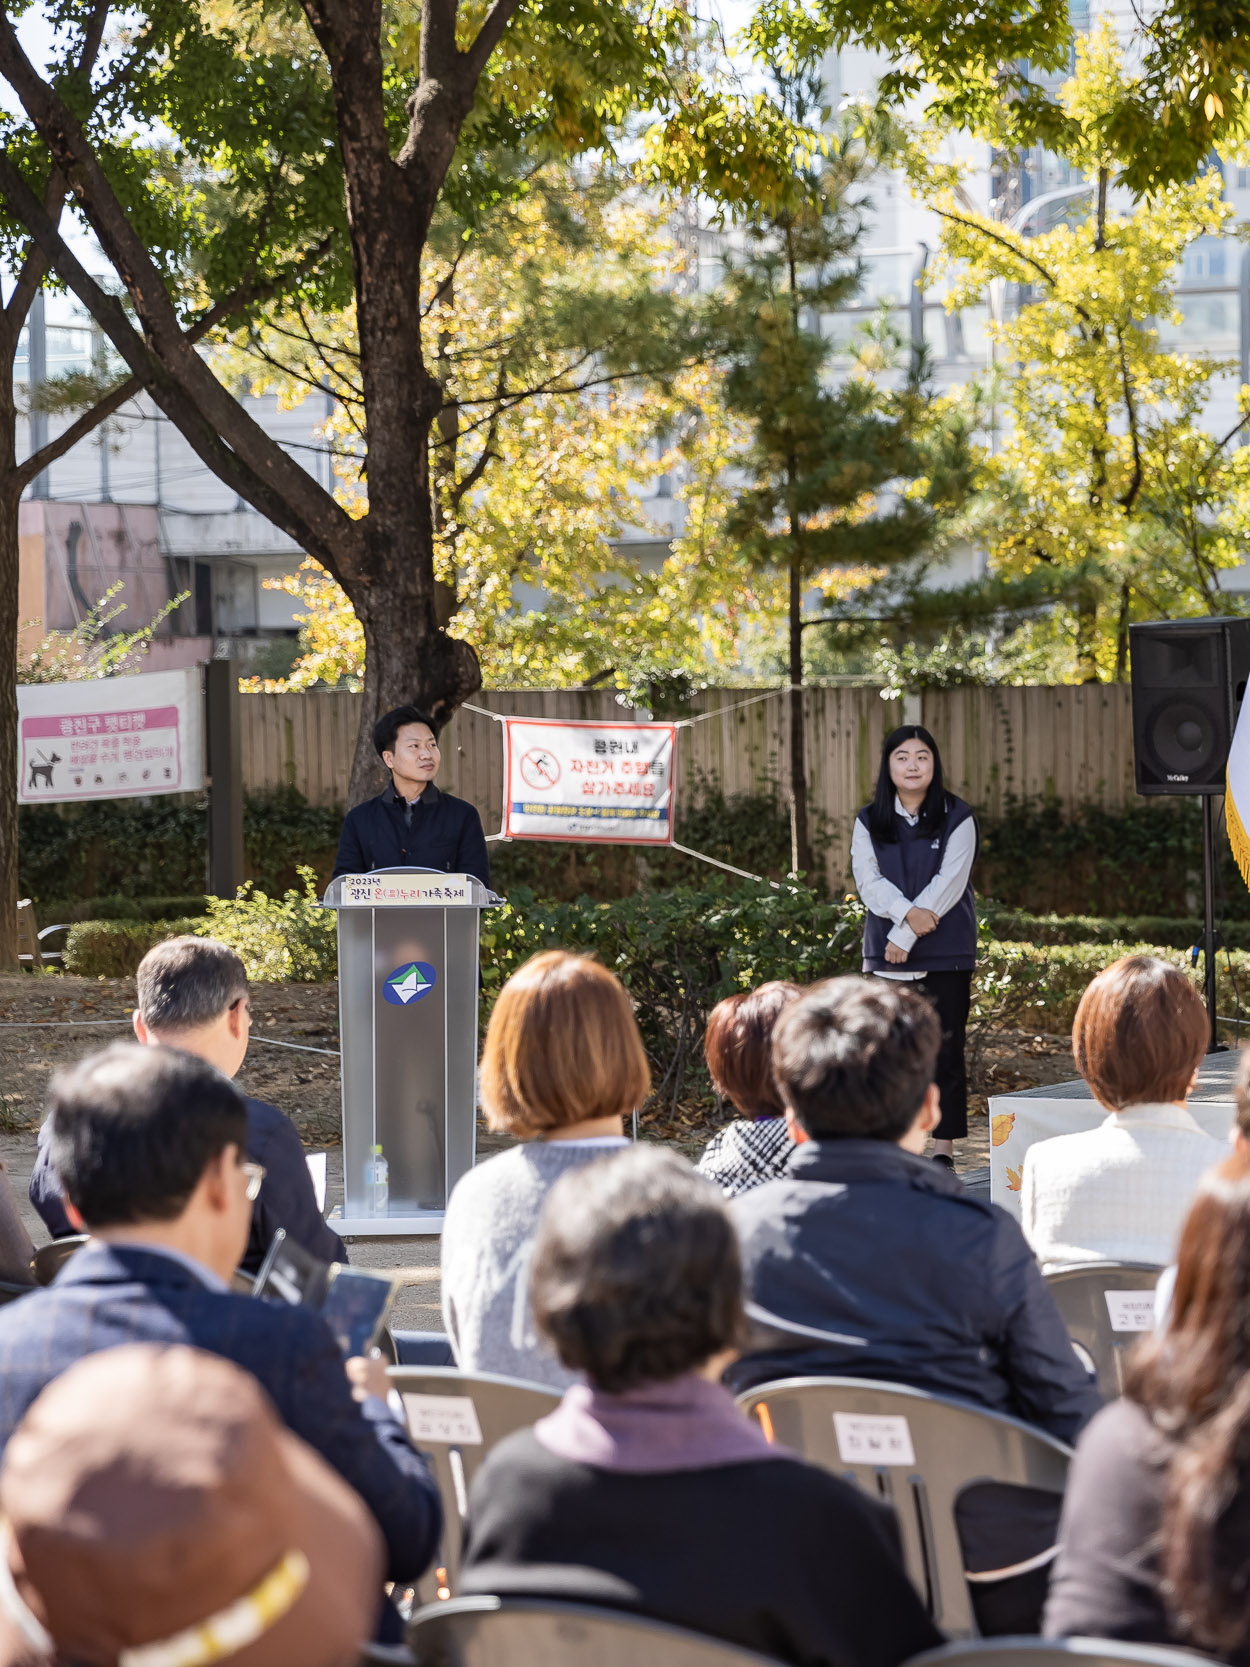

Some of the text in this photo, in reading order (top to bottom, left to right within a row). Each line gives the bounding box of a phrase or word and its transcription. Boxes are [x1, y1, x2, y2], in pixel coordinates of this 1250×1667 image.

[350, 878, 381, 886] 2023년
[350, 888, 371, 899] 광진
[422, 888, 464, 899] 가족축제
